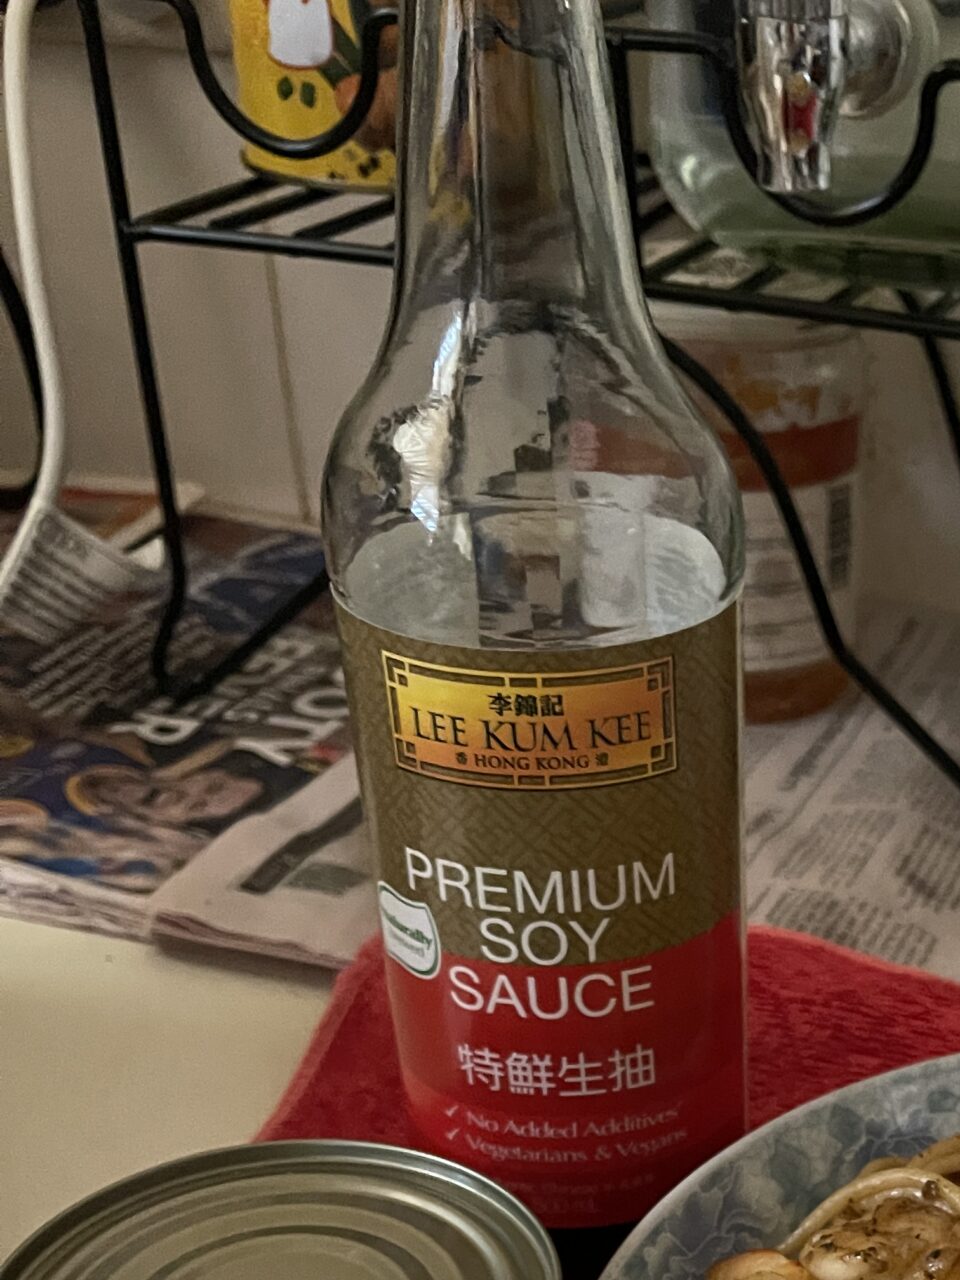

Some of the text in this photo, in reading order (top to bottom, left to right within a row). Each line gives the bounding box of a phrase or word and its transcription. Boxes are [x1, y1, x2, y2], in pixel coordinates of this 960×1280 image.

[487, 692, 564, 717] 李錦記
[409, 707, 652, 753] LEE KUM KEE
[473, 753, 530, 770] HONG
[535, 753, 590, 770] KONG
[405, 846, 676, 915] PREMIUM
[480, 917, 610, 966] SOY
[448, 965, 656, 1020] SAUCE
[457, 1043, 657, 1097] 特鮮生抽
[464, 1129, 688, 1163] Vegetarians & Vegans
[466, 1111, 499, 1133] No
[503, 1118, 577, 1138] Added
